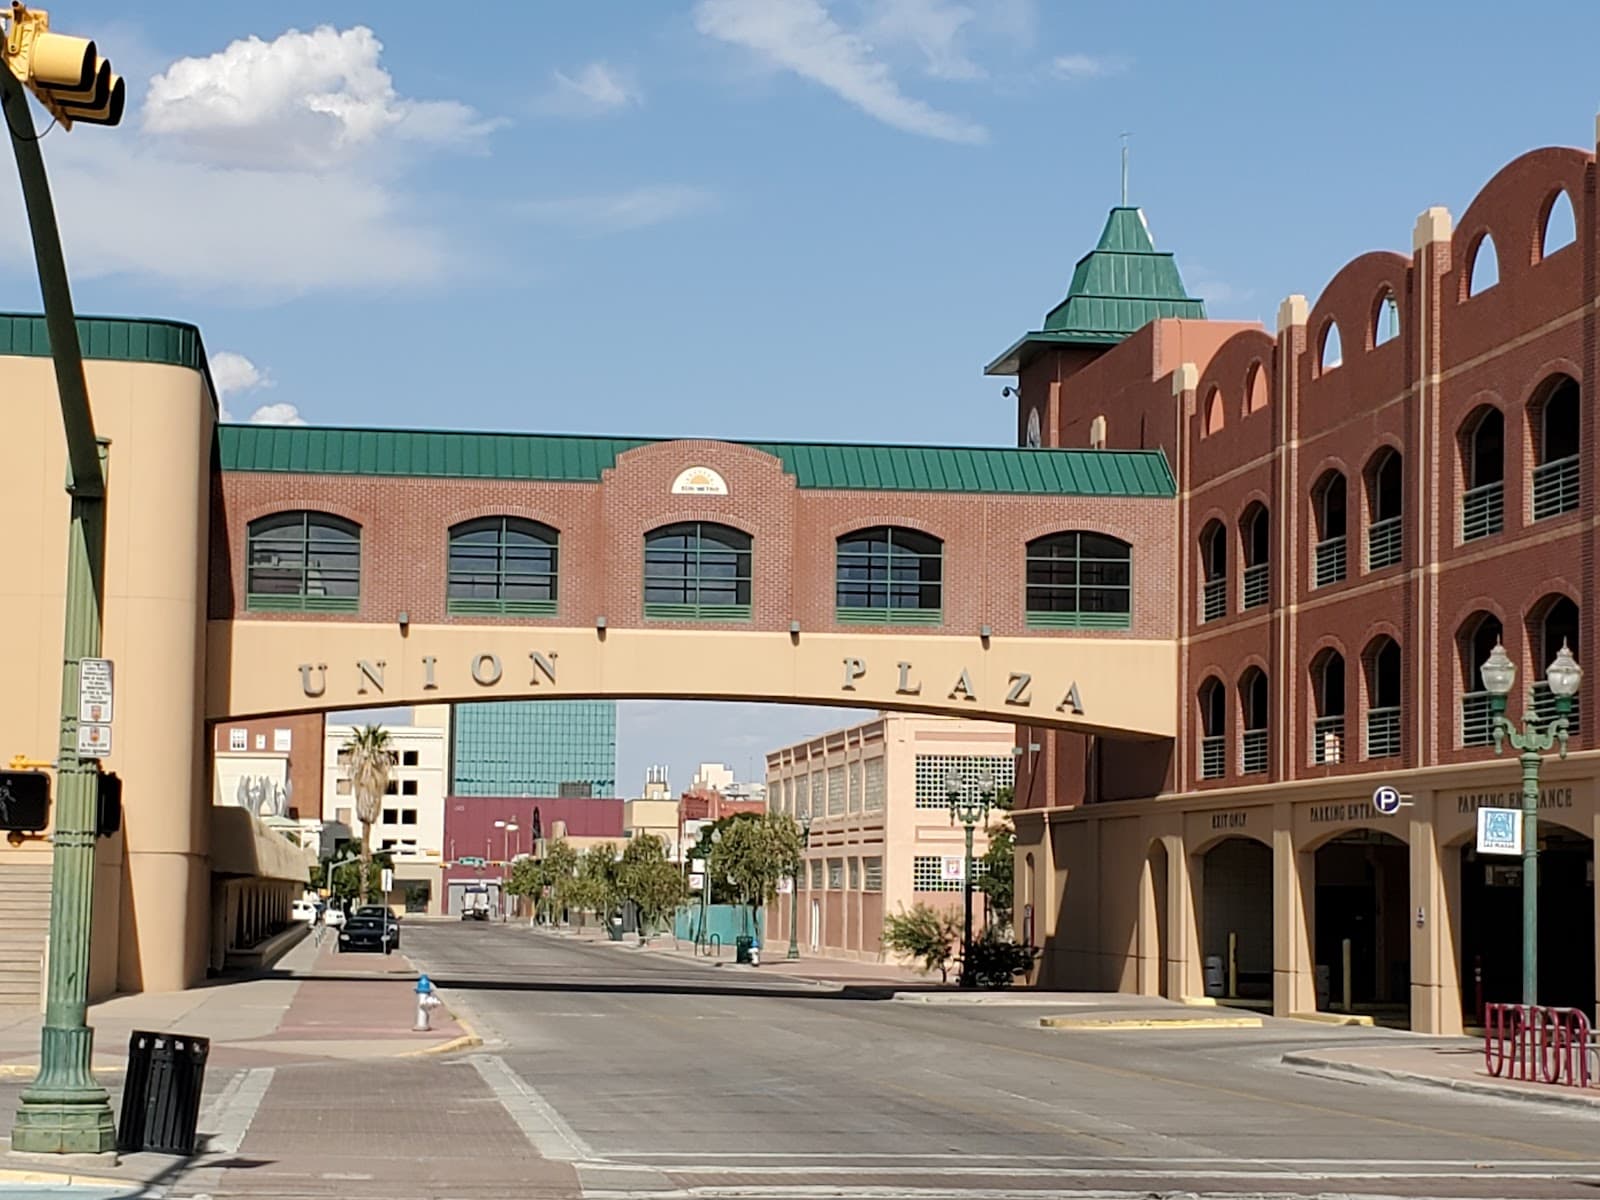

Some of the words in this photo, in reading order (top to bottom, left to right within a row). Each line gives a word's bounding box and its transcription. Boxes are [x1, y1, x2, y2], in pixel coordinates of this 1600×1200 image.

[298, 651, 558, 698] UNION
[841, 656, 1084, 715] PLAZA
[1381, 790, 1397, 810] P
[1457, 792, 1504, 813] PARKING
[1310, 804, 1345, 822] PARKING
